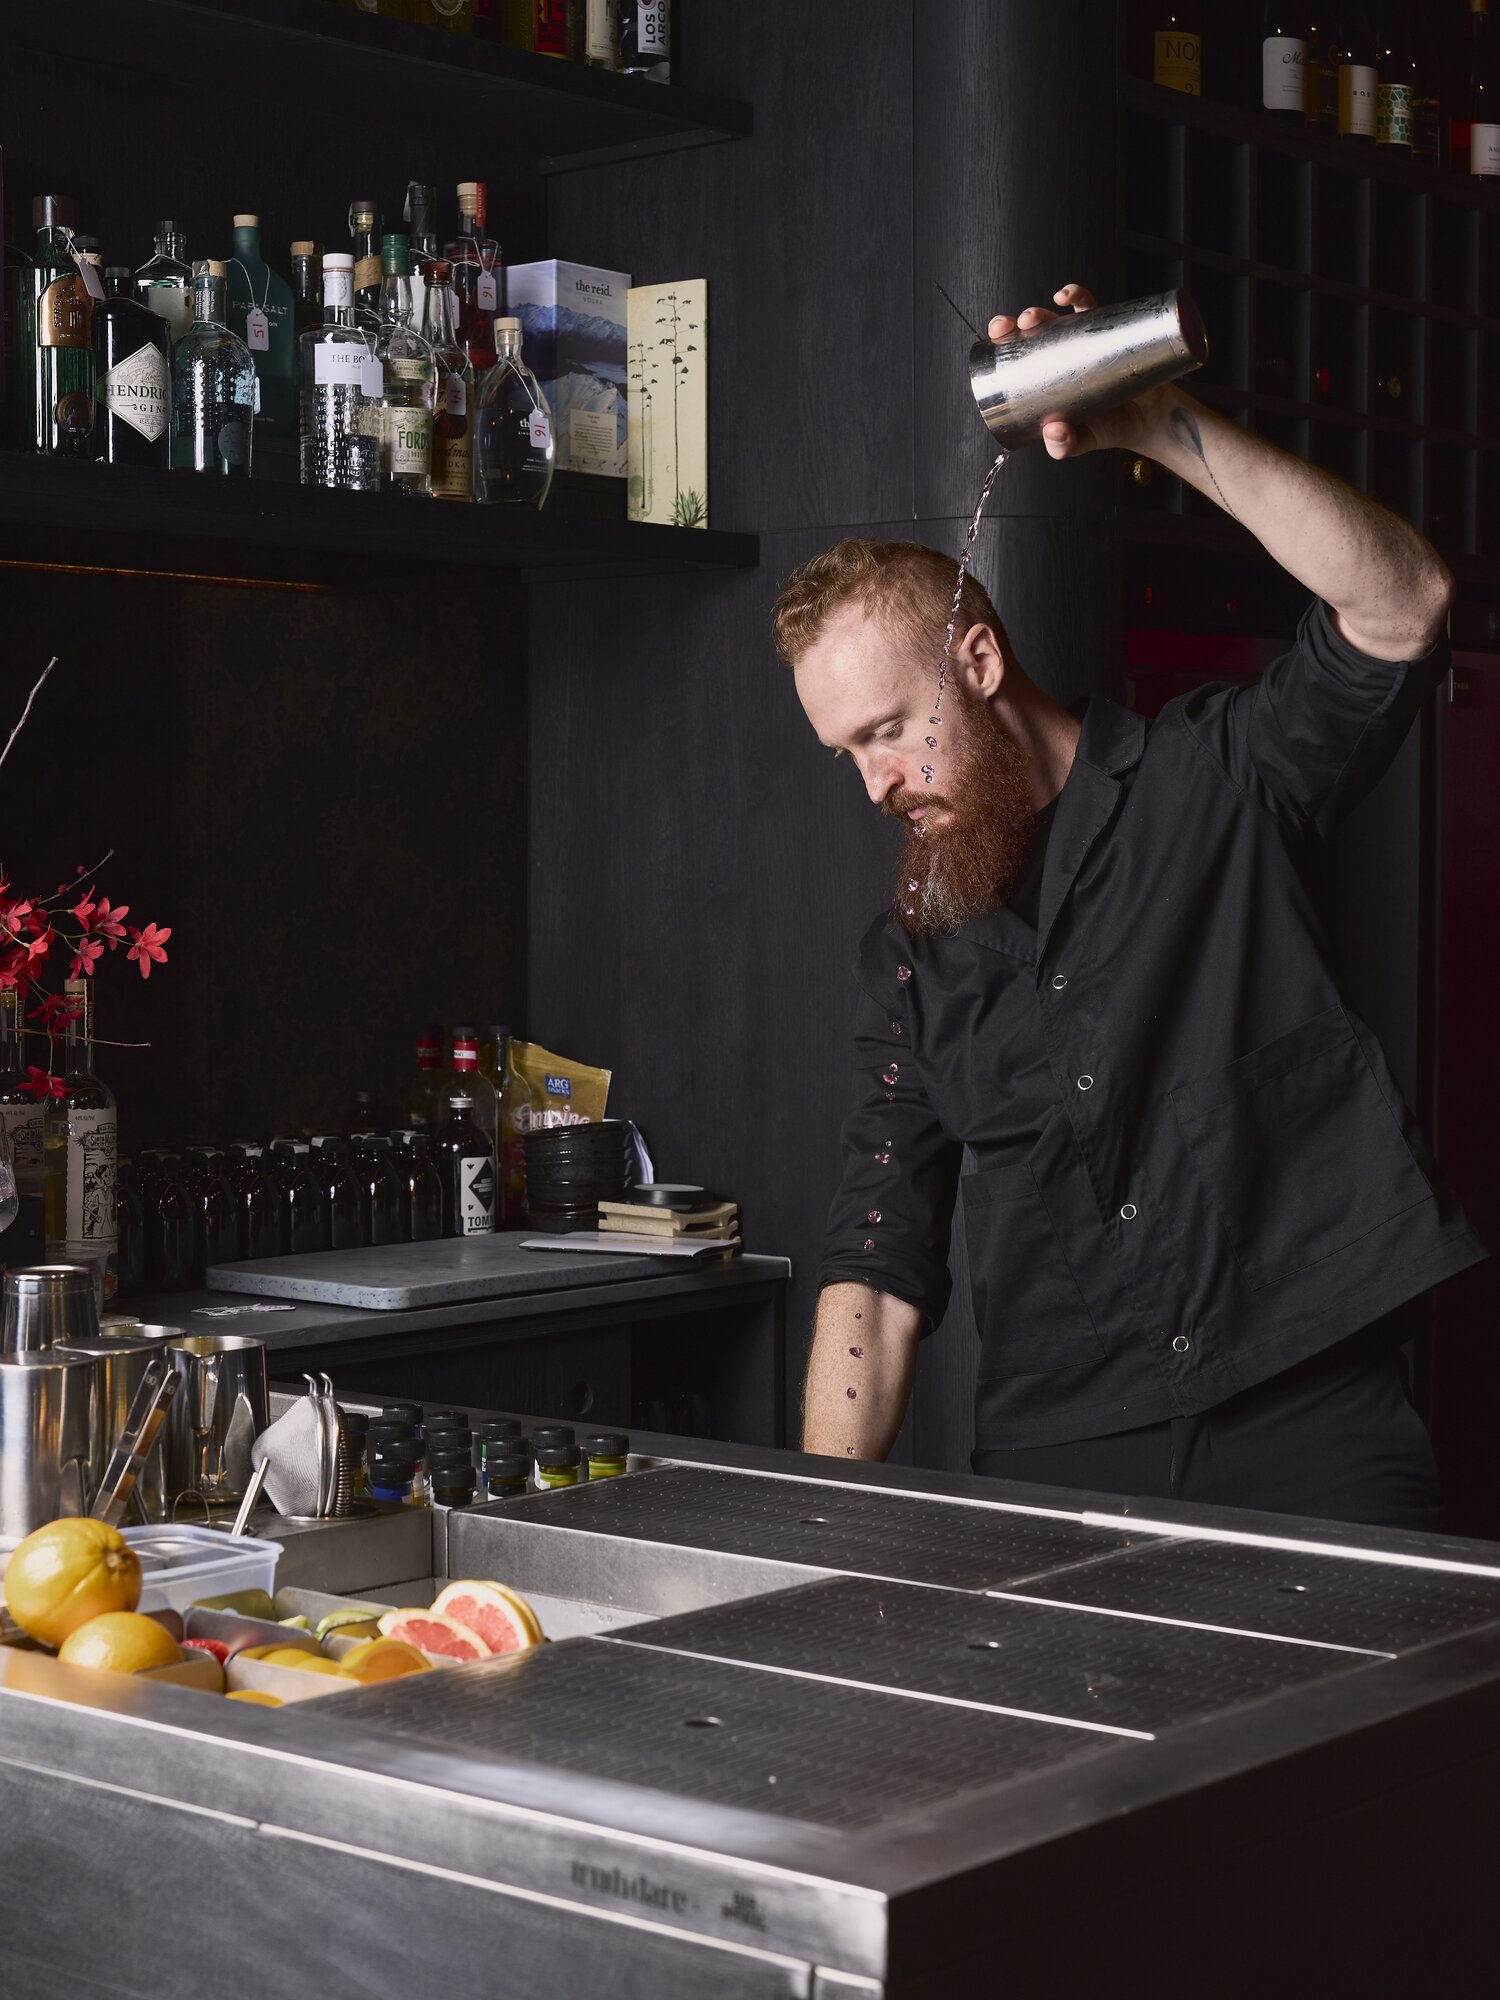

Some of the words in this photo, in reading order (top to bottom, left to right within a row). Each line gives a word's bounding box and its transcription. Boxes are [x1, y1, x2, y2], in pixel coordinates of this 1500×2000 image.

[645, 14, 656, 43] LOS
[576, 280, 590, 292] the
[232, 301, 259, 310] PAP
[263, 304, 288, 315] SALT
[331, 355, 350, 363] THE
[353, 355, 366, 364] BO
[140, 403, 161, 413] GIN
[520, 418, 530, 428] th
[548, 1078, 569, 1089] ARG
